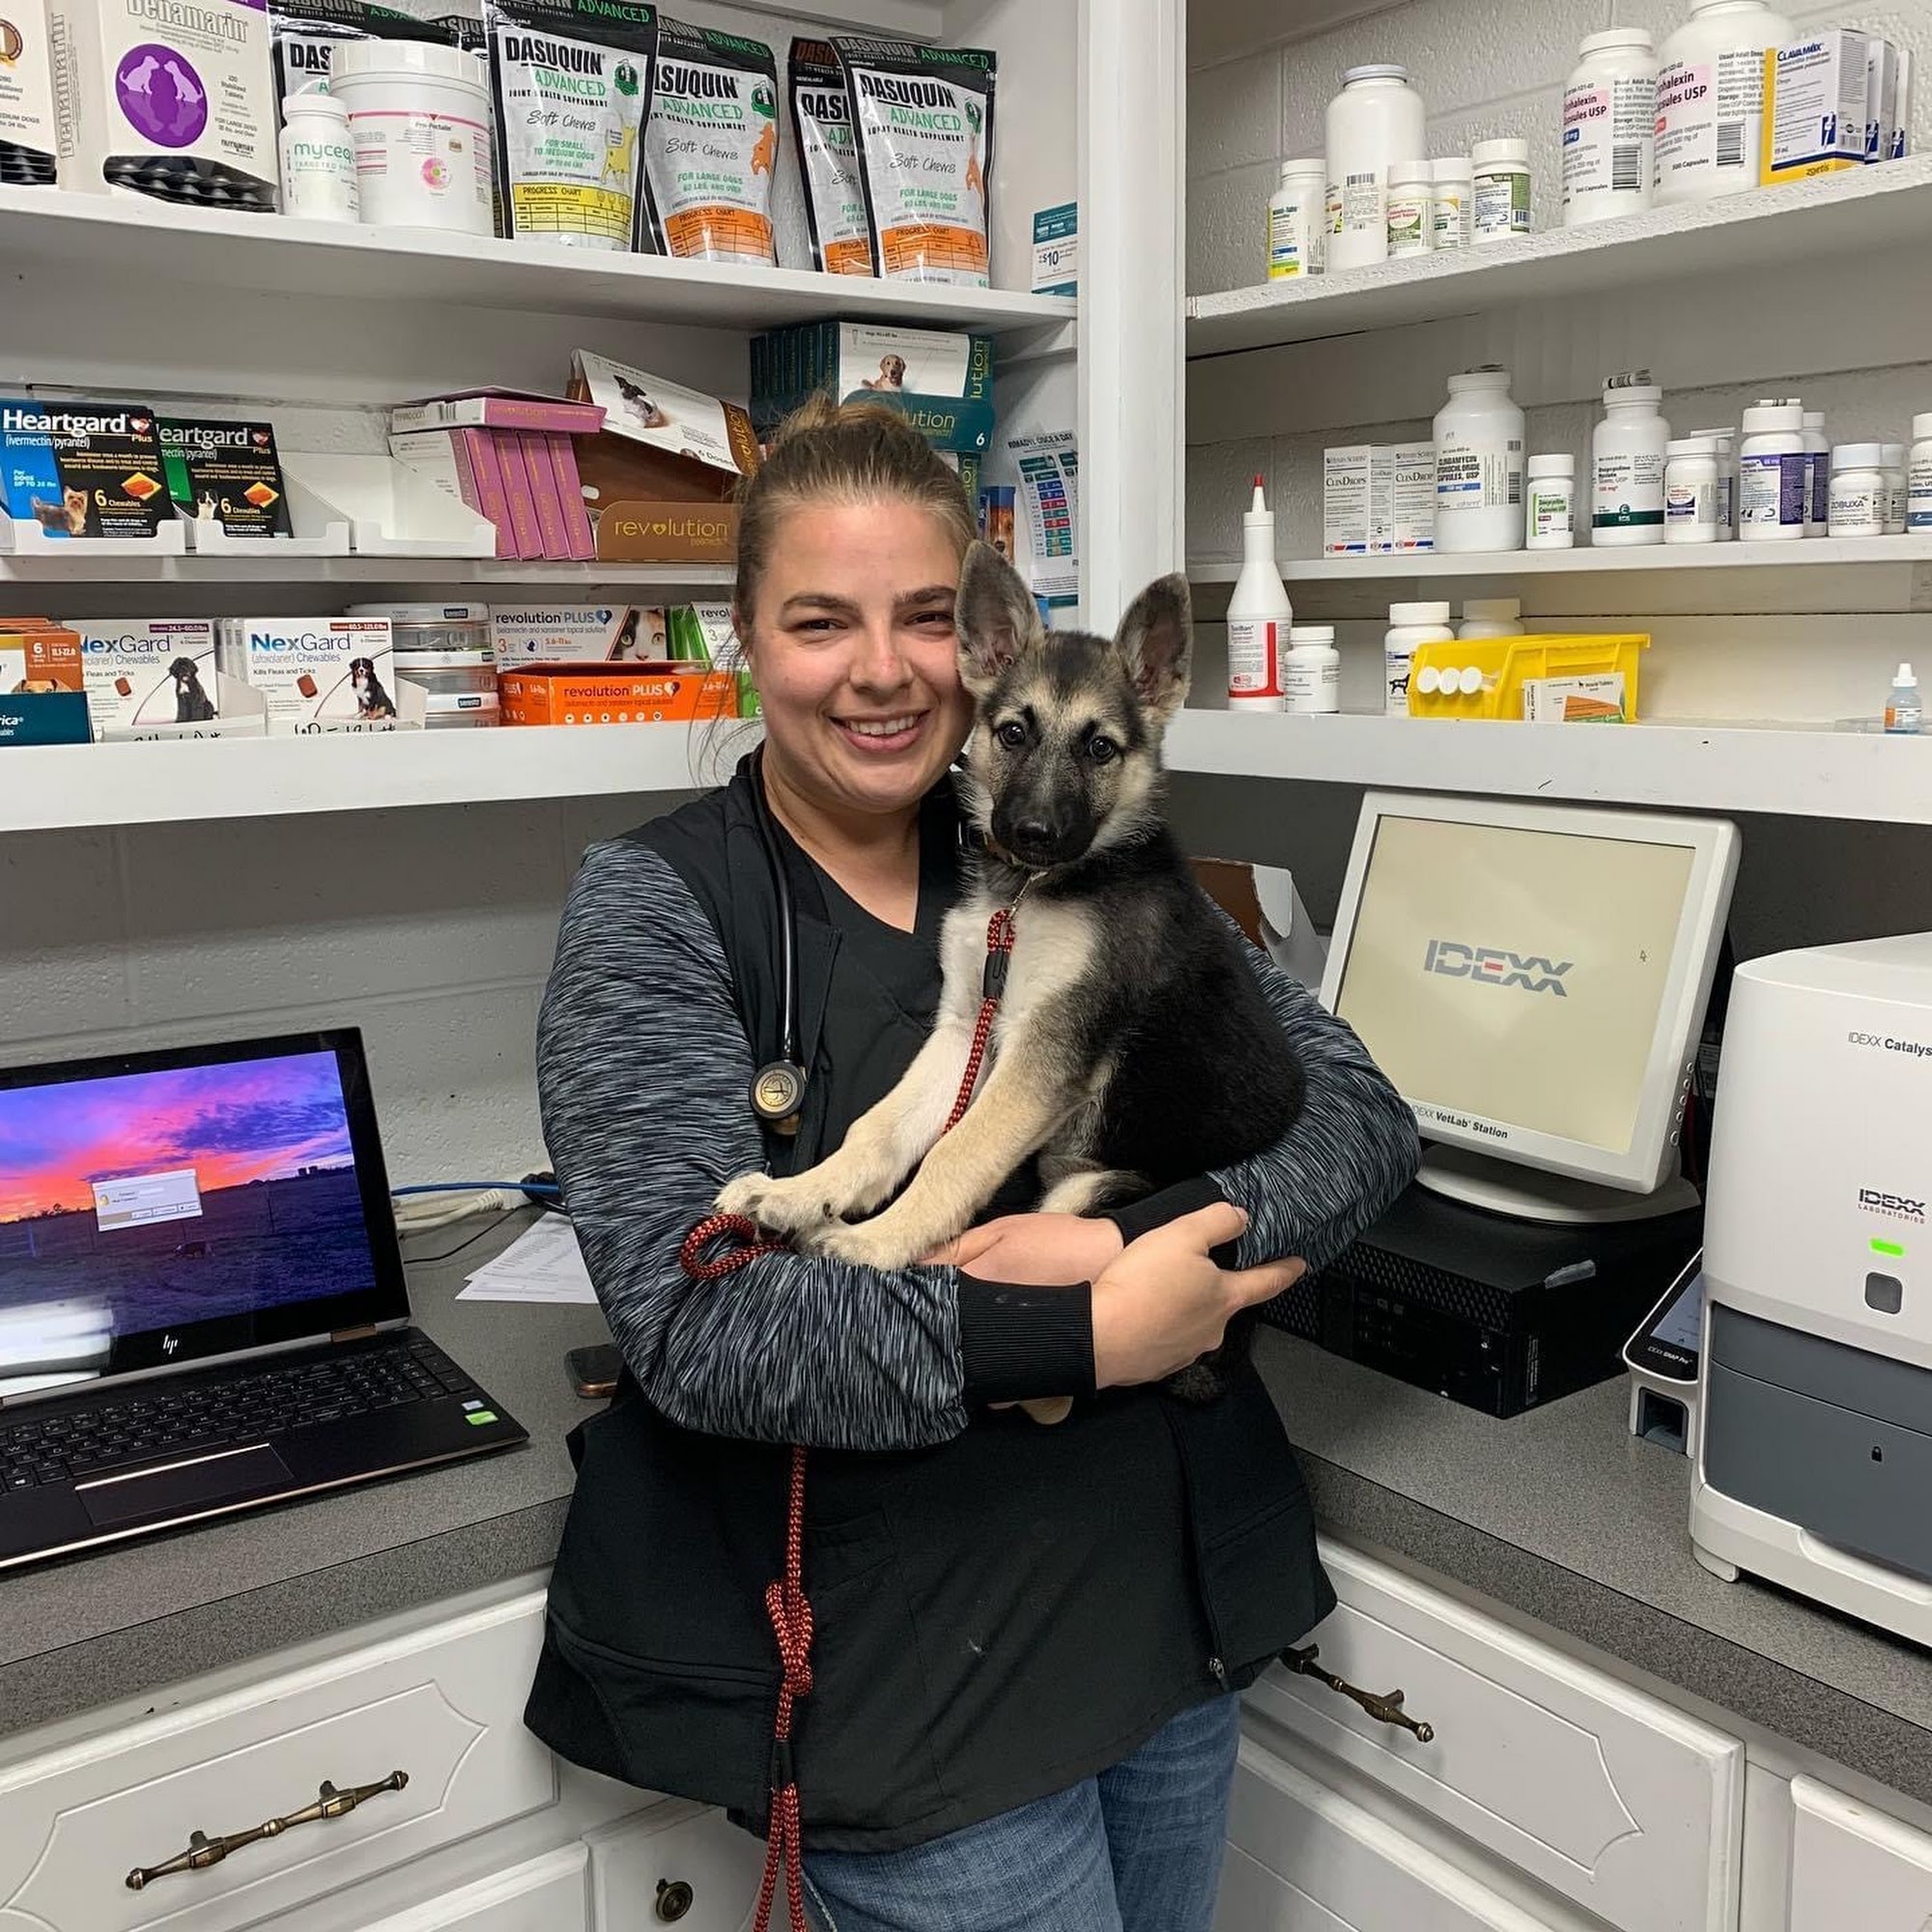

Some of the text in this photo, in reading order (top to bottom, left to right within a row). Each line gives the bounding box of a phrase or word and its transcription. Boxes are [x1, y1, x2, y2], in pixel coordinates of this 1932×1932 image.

[577, 0, 650, 22] ADVANCED
[505, 37, 603, 75] DASUQUIN
[837, 38, 989, 70] DASUQUIN ADVANCED
[535, 70, 607, 97] ADVANCED
[655, 64, 739, 99] SUQUIN
[859, 73, 956, 109] DASUQUIN
[1657, 71, 1694, 92] phalexin
[662, 98, 743, 120] ADVANCED
[1564, 95, 1598, 113] phalexin
[1655, 93, 1683, 112] psules
[1685, 85, 1708, 101] USP
[526, 110, 596, 131] Soft Chews
[890, 107, 961, 131] ADVANCED
[1588, 104, 1608, 118] USP
[294, 143, 355, 165] myceq
[665, 137, 739, 160] Soft Chews
[923, 157, 956, 174] Chews
[970, 341, 983, 399] lution
[3, 409, 127, 438] Heartgard
[156, 424, 248, 449] eartgard
[977, 432, 985, 446] 6
[95, 489, 107, 507] 6
[220, 497, 232, 514] 6
[614, 518, 728, 538] revolution
[496, 611, 595, 624] revolution PLUS
[700, 608, 731, 617] revol
[33, 642, 43, 654] 6
[251, 632, 352, 652] NexGard
[498, 638, 507, 653] 3
[116, 654, 160, 666] Chewables
[297, 652, 342, 664] Chewables
[564, 684, 664, 698] revolution PLUS
[1424, 939, 1574, 998] IDEXX
[1848, 1032, 1932, 1058] IDEXX Catalys
[1413, 1104, 1435, 1119] DEXX
[1472, 1121, 1508, 1140] Station
[1860, 1188, 1925, 1216] IDEXX
[1858, 1204, 1925, 1224] LABORATORIES
